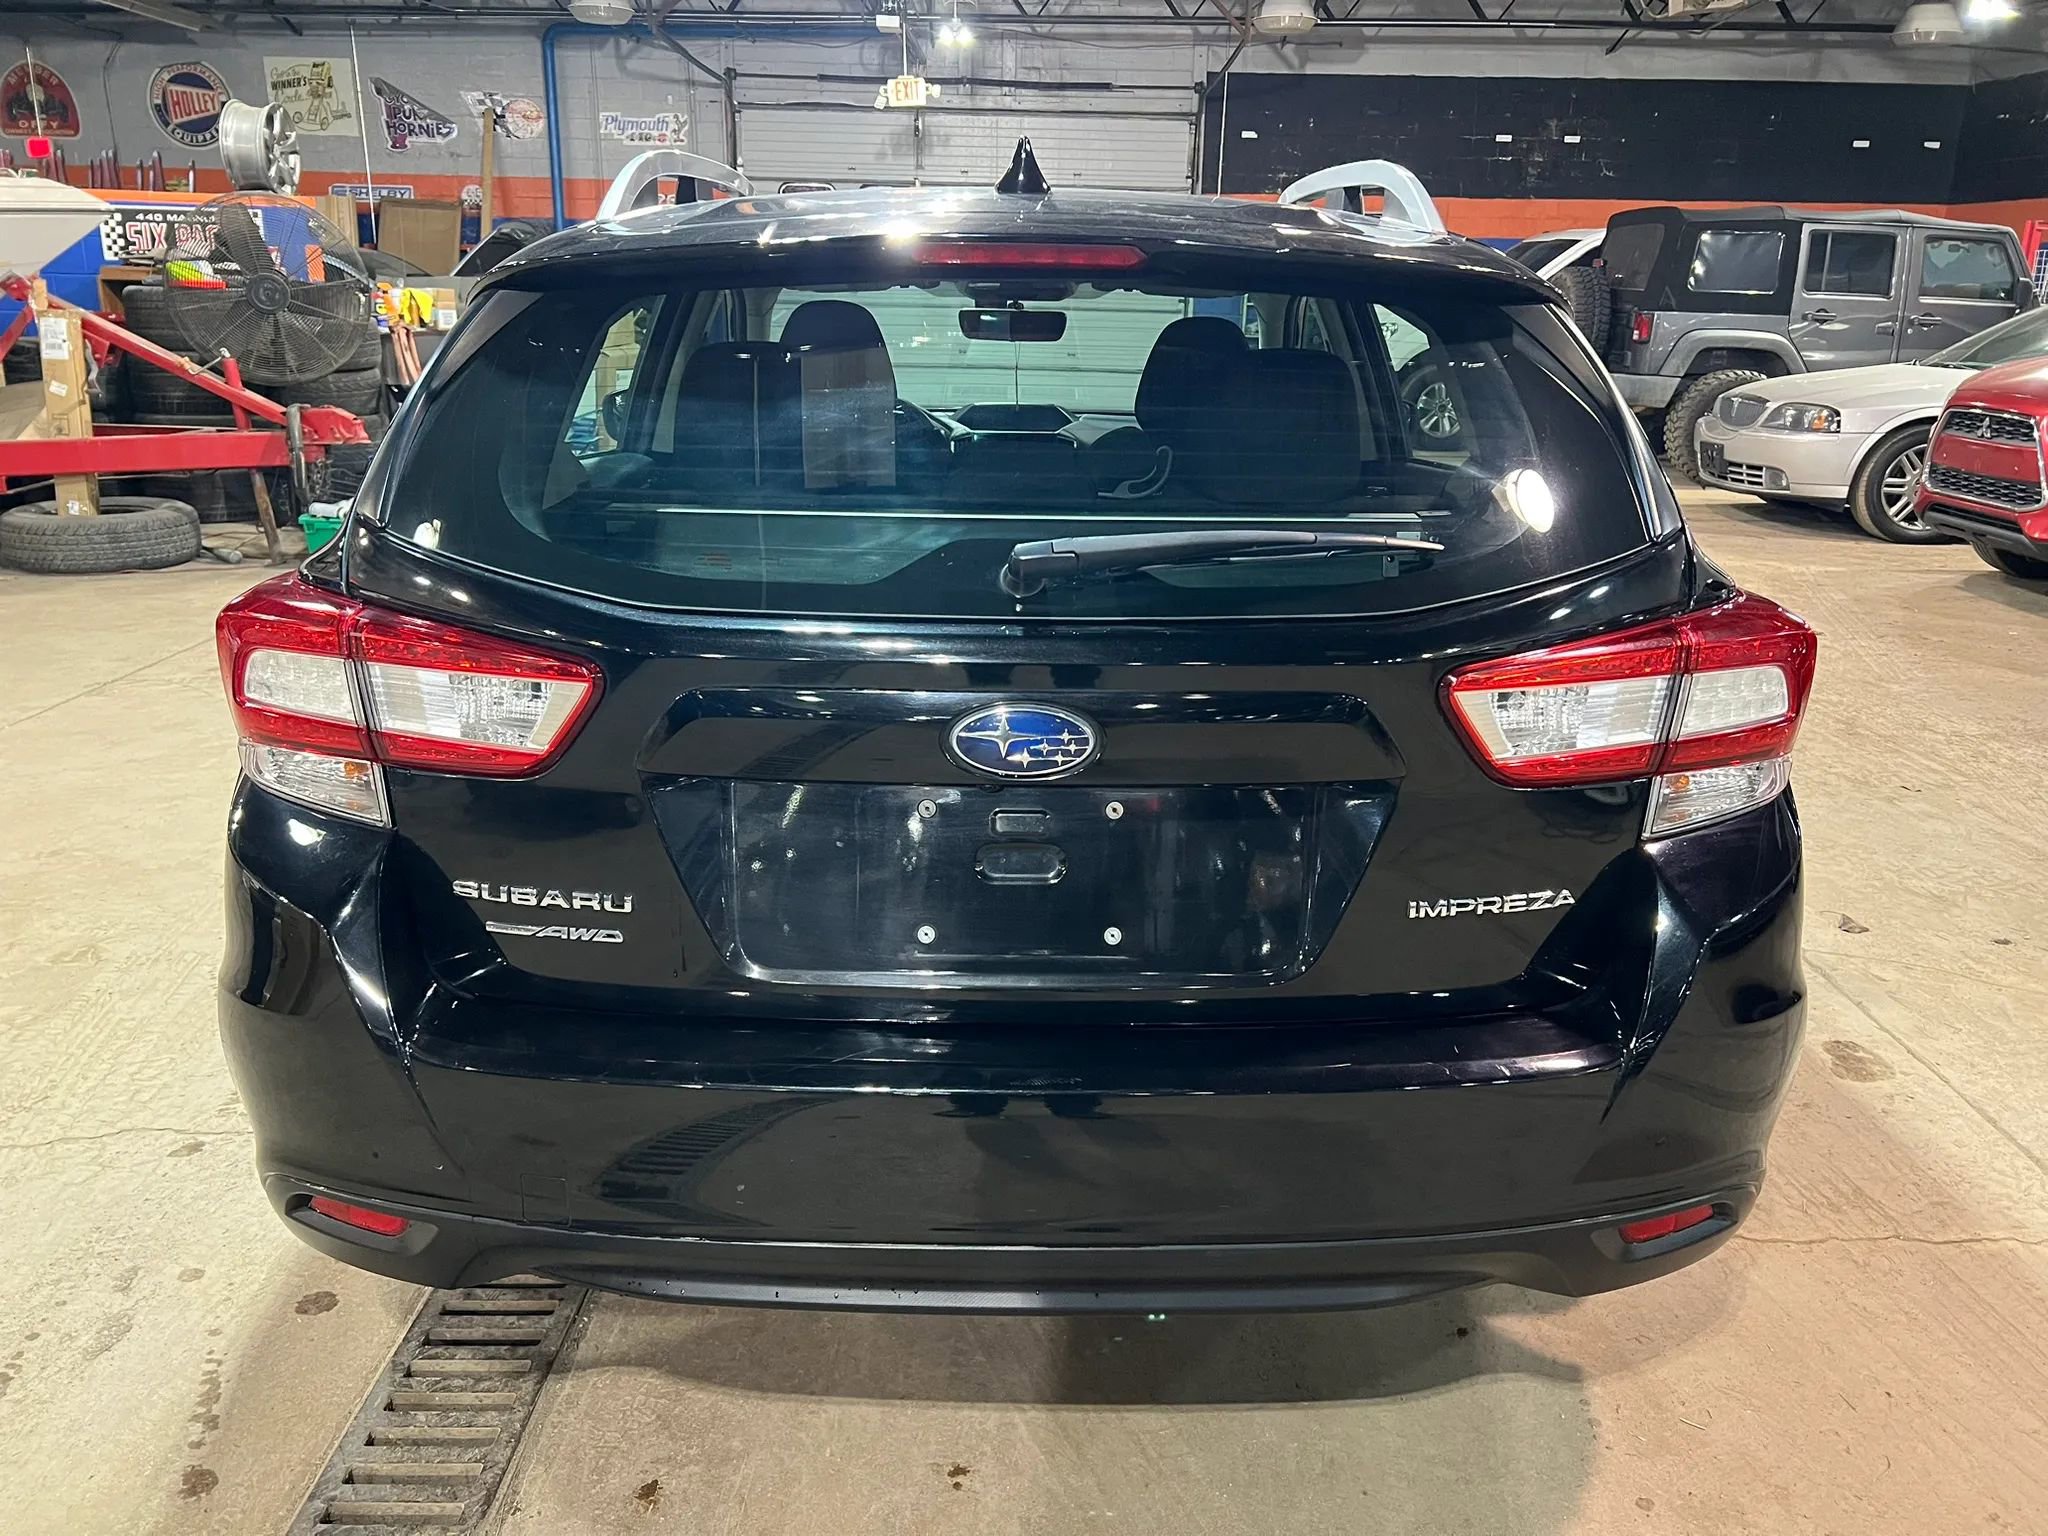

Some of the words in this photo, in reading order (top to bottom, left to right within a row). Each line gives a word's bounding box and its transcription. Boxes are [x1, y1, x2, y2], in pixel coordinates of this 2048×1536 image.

[270, 76, 307, 91] WINNER'S
[895, 81, 920, 102] EXIT
[169, 89, 217, 119] HOLLEY
[602, 114, 669, 136] Plymouth
[135, 212, 163, 222] 440
[125, 222, 167, 253] SIX
[452, 879, 633, 913] SUBARU
[1408, 889, 1576, 919] IMPREZA
[535, 925, 624, 943] AWD
